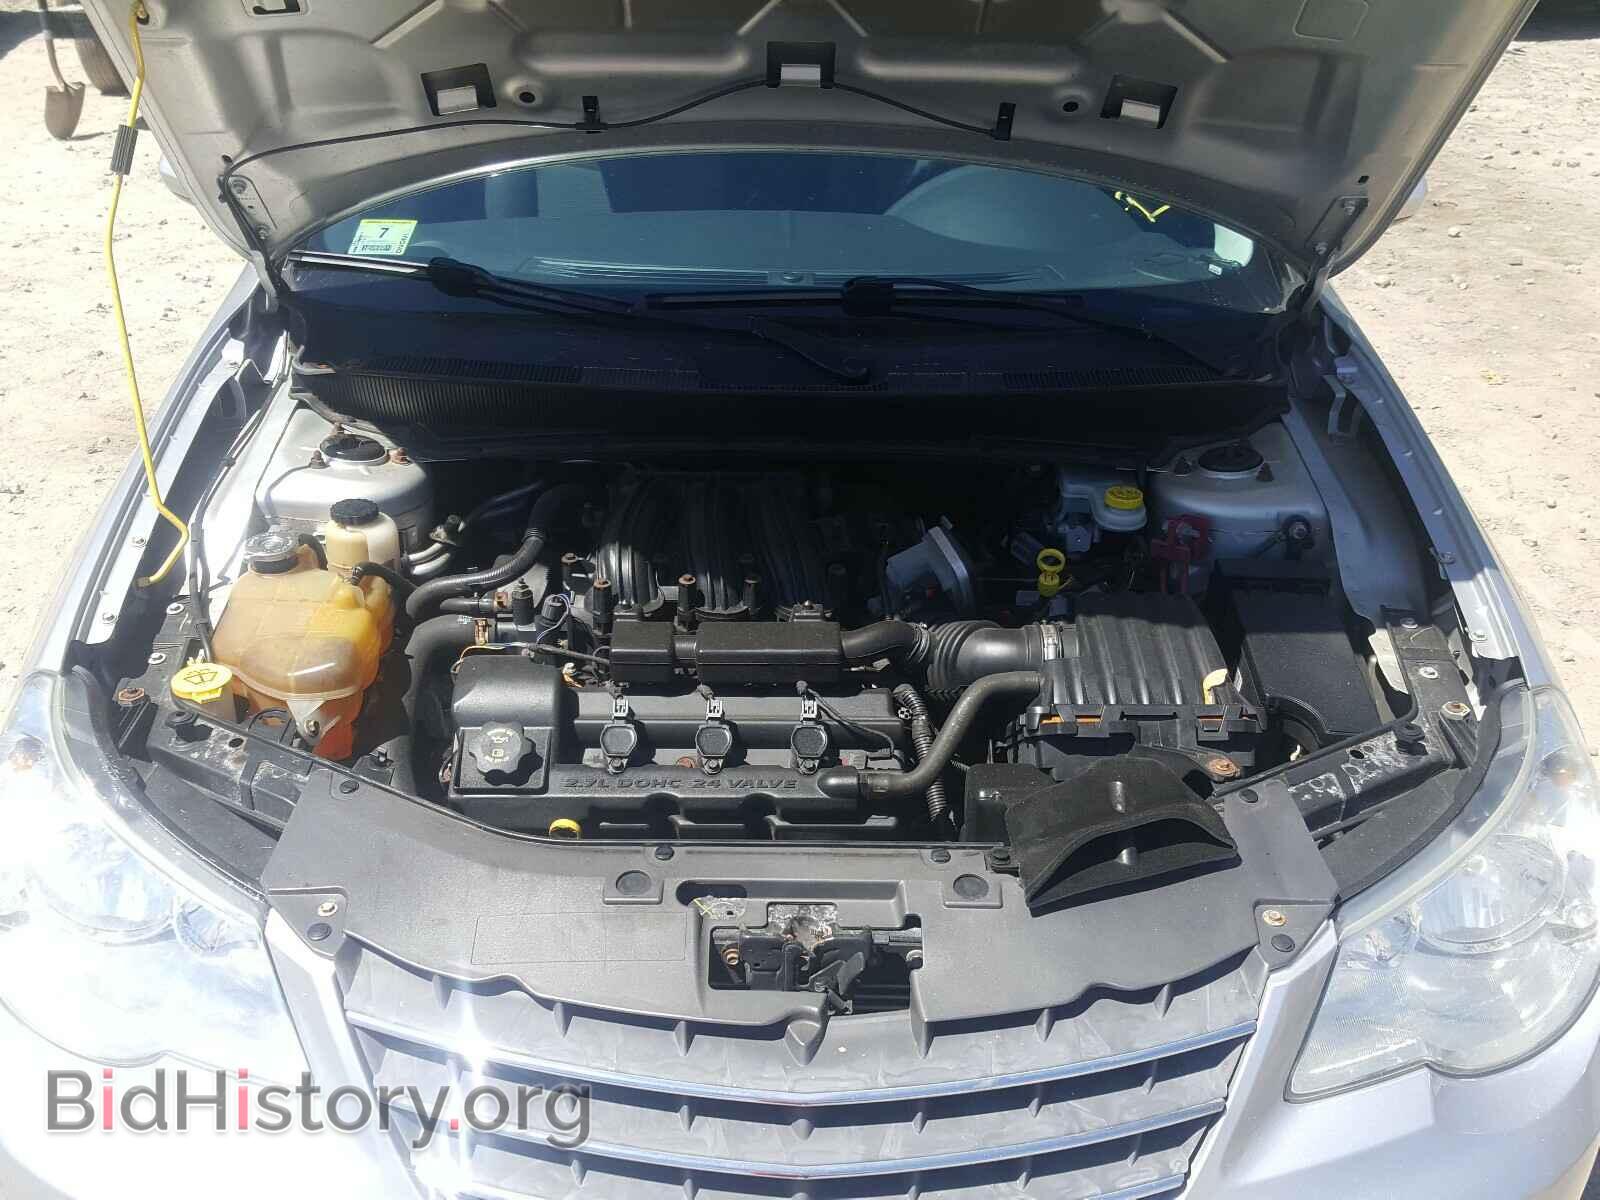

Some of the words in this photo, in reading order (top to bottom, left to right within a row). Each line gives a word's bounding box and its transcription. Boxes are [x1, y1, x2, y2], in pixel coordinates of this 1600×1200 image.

[379, 227, 390, 239] 7
[563, 777, 610, 788] 2.7L
[617, 777, 681, 788] DOHC
[687, 778, 721, 789] 24
[728, 778, 798, 789] VALVE
